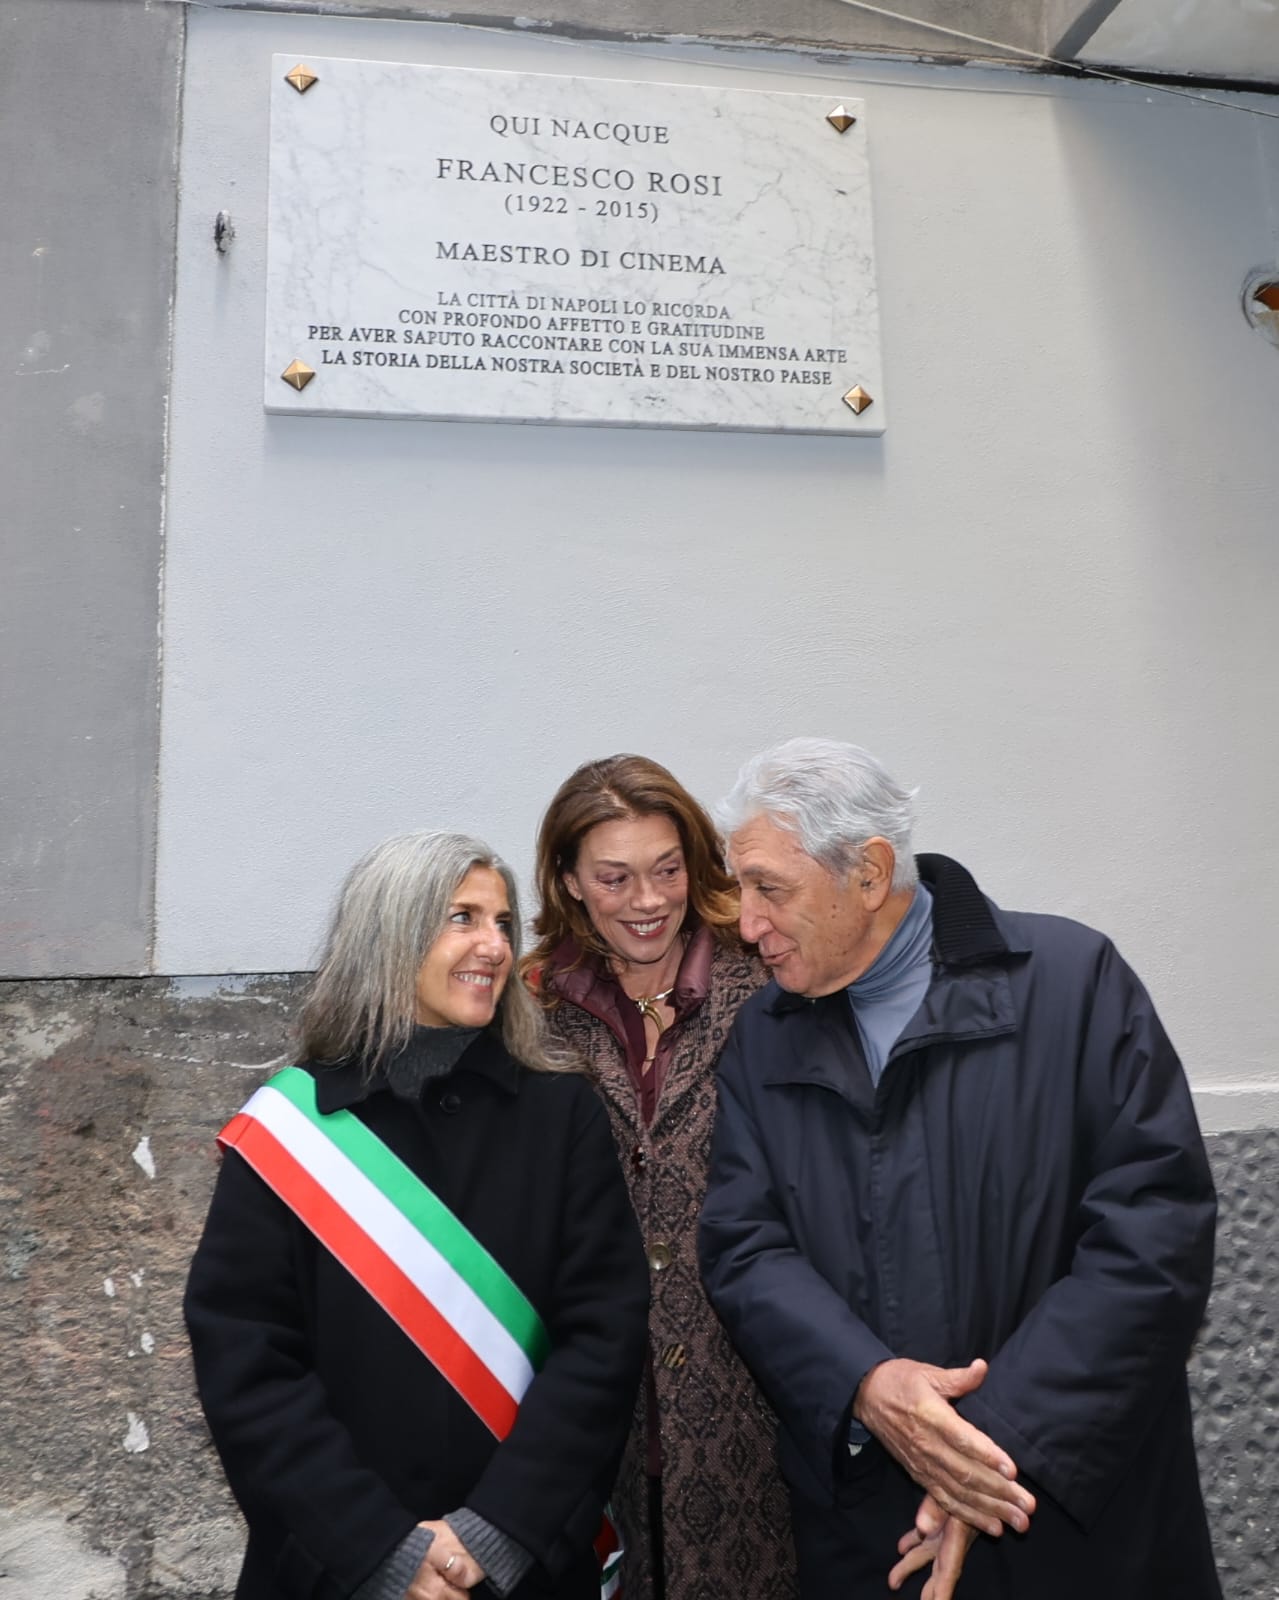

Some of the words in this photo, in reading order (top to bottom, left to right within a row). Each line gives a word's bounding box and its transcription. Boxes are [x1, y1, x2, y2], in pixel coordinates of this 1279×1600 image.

[489, 114, 541, 138] QUI
[550, 118, 670, 147] NACQUE
[435, 157, 635, 191] FRANCESCO
[647, 171, 723, 197] ROSI
[504, 193, 569, 215] (1922
[595, 199, 659, 224] 2015)
[435, 241, 571, 266] MAESTRO
[580, 248, 610, 269] DI
[619, 251, 727, 275] CINEMA
[437, 291, 462, 307] LA
[466, 289, 520, 310] CITTÀ
[526, 295, 546, 311] DI
[550, 296, 618, 314] NAPOLI
[623, 300, 647, 316] LO
[651, 301, 731, 320] RICORDA
[398, 309, 438, 325] CON
[443, 311, 542, 330] PROFONDO
[546, 316, 625, 334] AFFETTO
[631, 320, 642, 335] E
[647, 321, 766, 341] GRATITUDINE
[307, 324, 344, 342] PER
[348, 327, 398, 344] AVER
[403, 329, 476, 347] SAPUTO
[481, 332, 603, 353] RACCONTARE
[608, 338, 646, 354] CON
[651, 340, 675, 356] LA
[678, 342, 714, 358] SUA
[718, 343, 800, 362] IMMENSA
[803, 348, 848, 364] ARTE
[321, 349, 348, 366] LA
[352, 350, 422, 369] STORIA
[425, 353, 487, 372] DELLA
[490, 356, 566, 375] NOSTRA
[569, 357, 645, 378] SOCIETÀ
[649, 363, 662, 378] E
[666, 364, 701, 380] DEL
[704, 366, 775, 383] NOSTRO
[780, 369, 833, 386] PAESE
